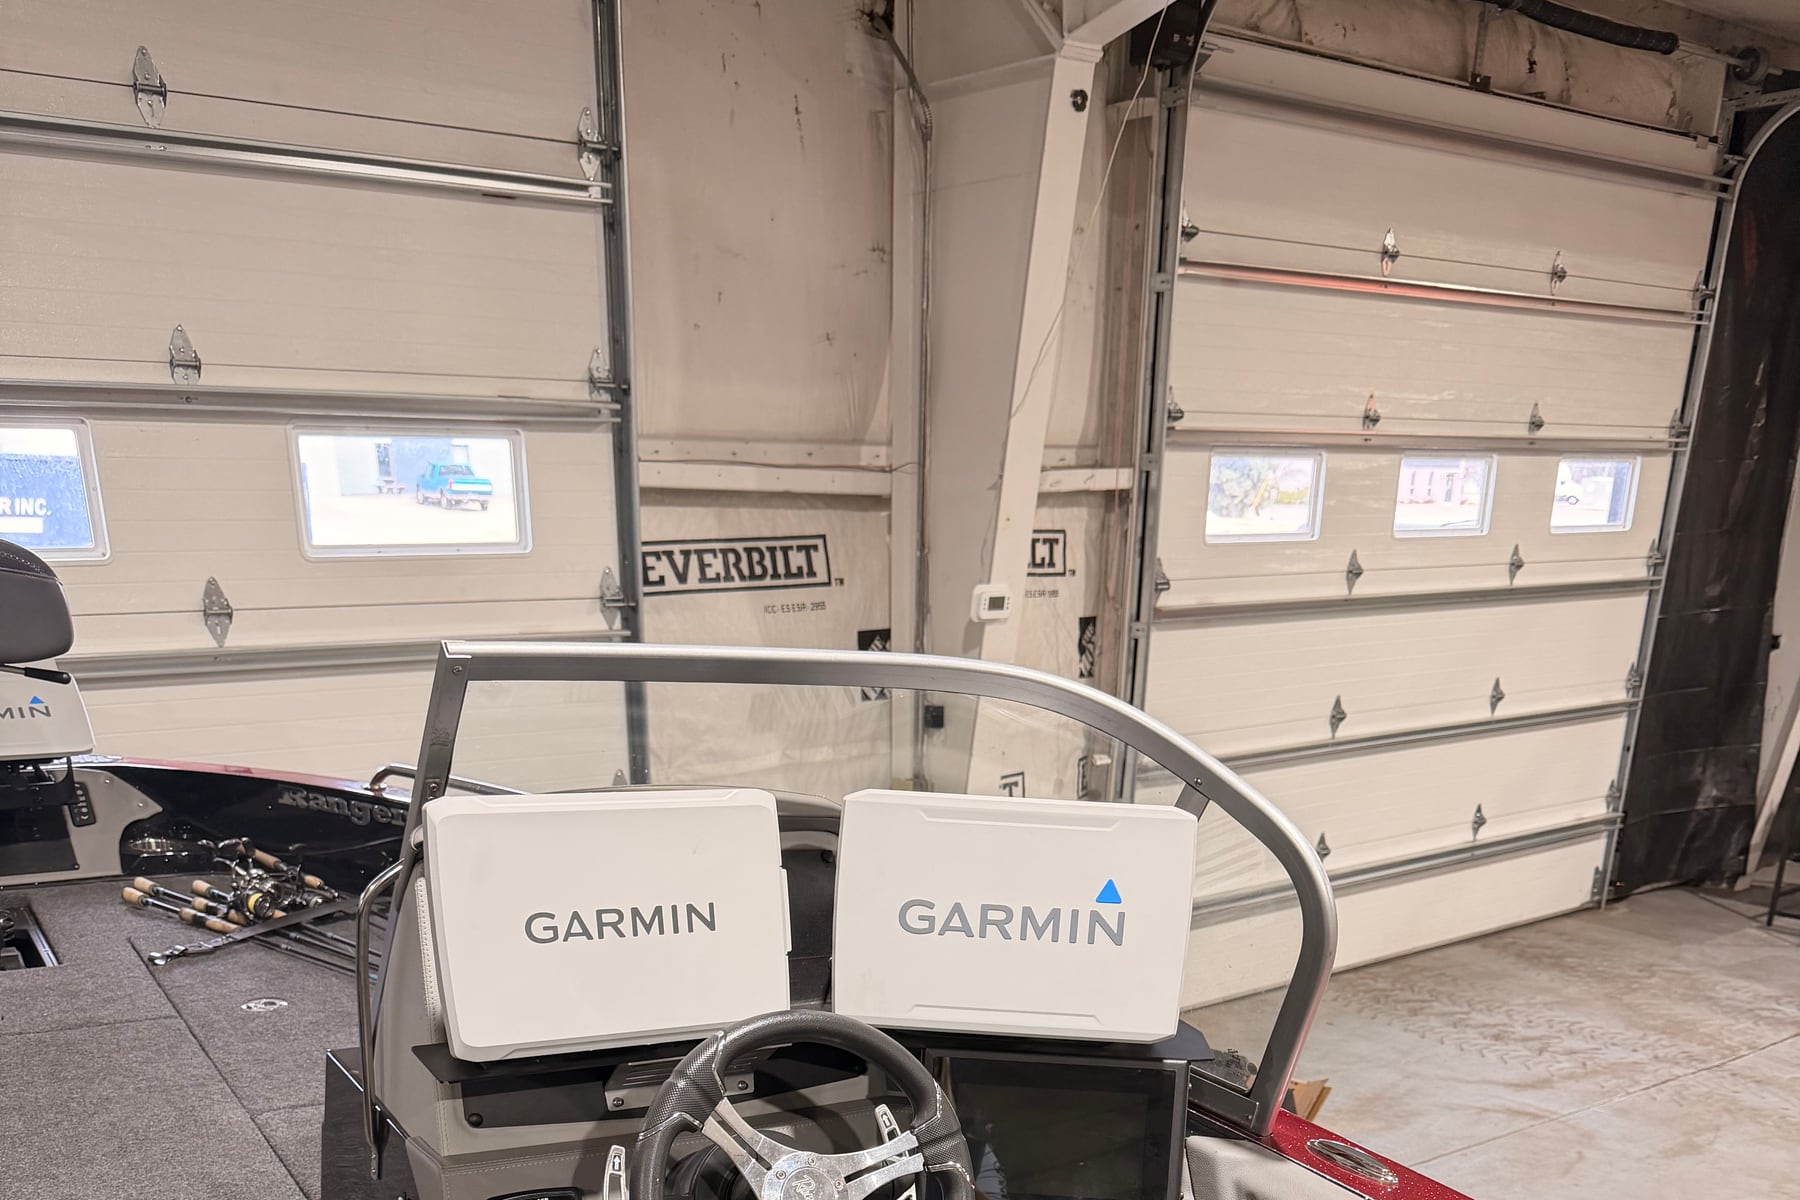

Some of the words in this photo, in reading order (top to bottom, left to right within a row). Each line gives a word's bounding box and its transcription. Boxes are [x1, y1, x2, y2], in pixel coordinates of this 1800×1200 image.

[15, 497, 52, 516] INC.
[641, 544, 818, 587] EVERBILT
[278, 784, 409, 827] Ranger
[524, 901, 717, 945] GARMIN
[898, 898, 1126, 947] GARMIN
